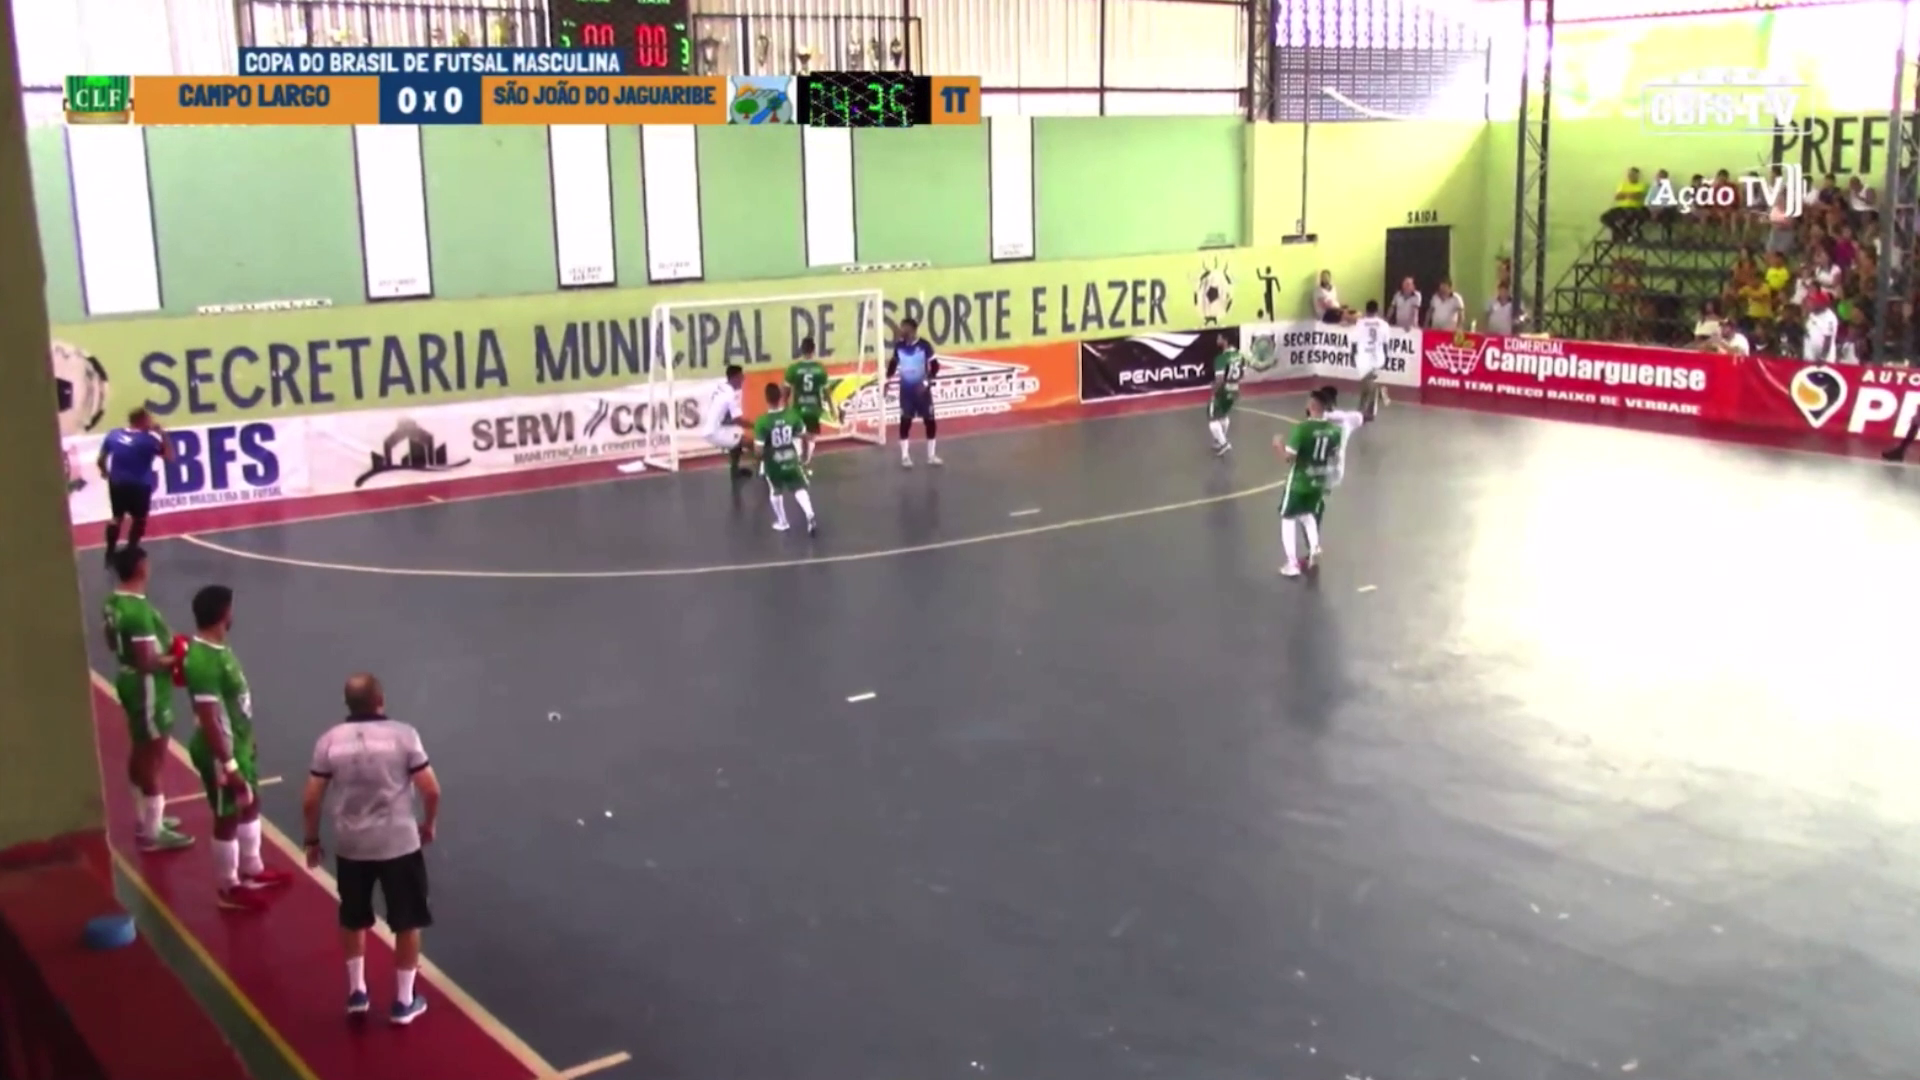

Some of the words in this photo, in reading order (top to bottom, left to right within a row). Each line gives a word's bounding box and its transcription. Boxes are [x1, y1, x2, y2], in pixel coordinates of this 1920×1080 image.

[139, 329, 509, 415] SECRETARIA
[534, 308, 771, 384] MUNICIPAL
[790, 303, 834, 360] DE
[1032, 287, 1047, 336] E
[1061, 279, 1167, 333] LAZER
[1283, 331, 1349, 348] SECRETARIA
[1504, 337, 1564, 355] COMERCIAL
[1290, 350, 1306, 364] DE
[1484, 346, 1707, 391] Campolarguense
[803, 374, 814, 392] 5
[1119, 363, 1204, 386] PENALTY
[1861, 369, 1920, 386] AUTO
[1428, 376, 1460, 389] AQUI
[1464, 379, 1494, 393] TEM
[1547, 388, 1596, 404] BAIXO
[1600, 395, 1620, 407] DE
[1624, 397, 1702, 415] VERDADE
[471, 410, 575, 452] SERVI
[611, 398, 700, 436] CONS
[1313, 436, 1328, 460] 11
